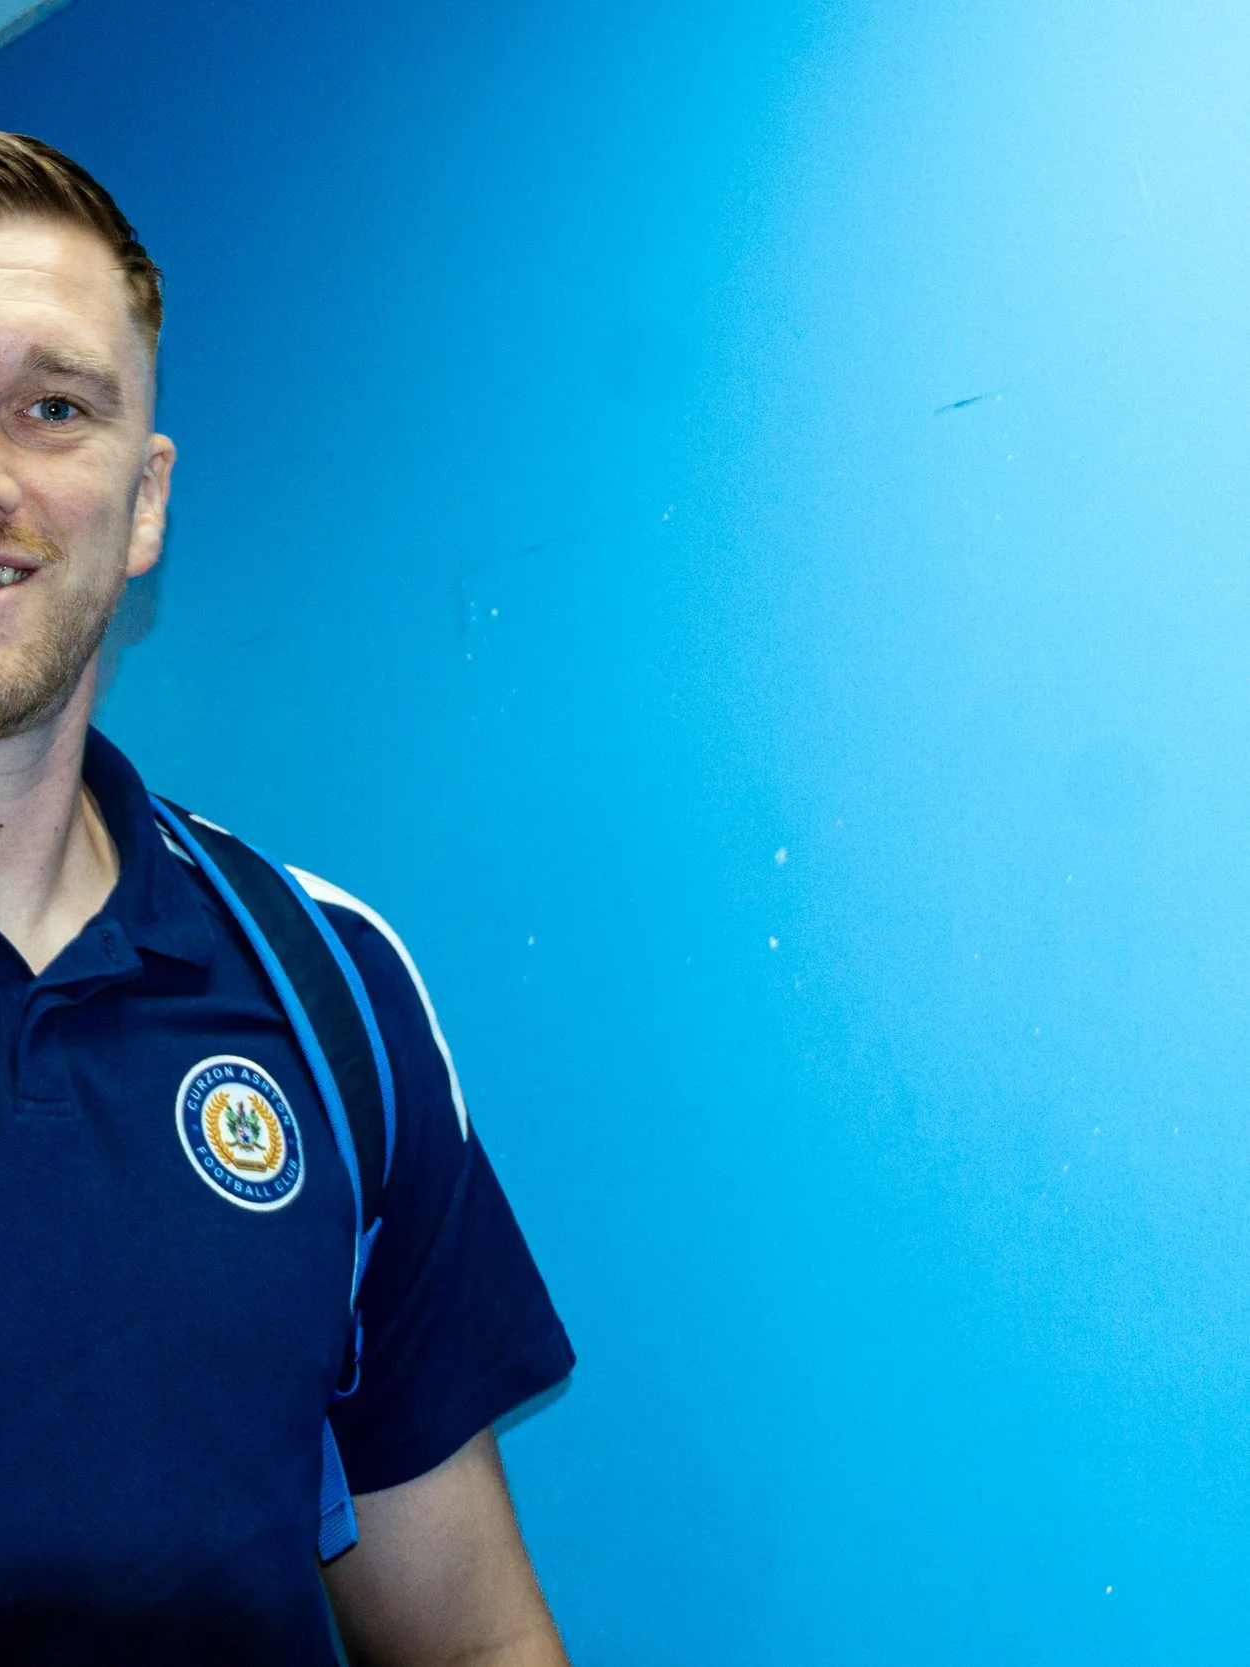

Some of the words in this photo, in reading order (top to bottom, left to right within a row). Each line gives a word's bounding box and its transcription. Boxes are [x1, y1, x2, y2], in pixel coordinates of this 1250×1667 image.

[187, 1066, 234, 1111] CURZON
[240, 1068, 292, 1125] ASHTON
[196, 1146, 271, 1197] FOOTBALL
[274, 1158, 297, 1191] CLUB
